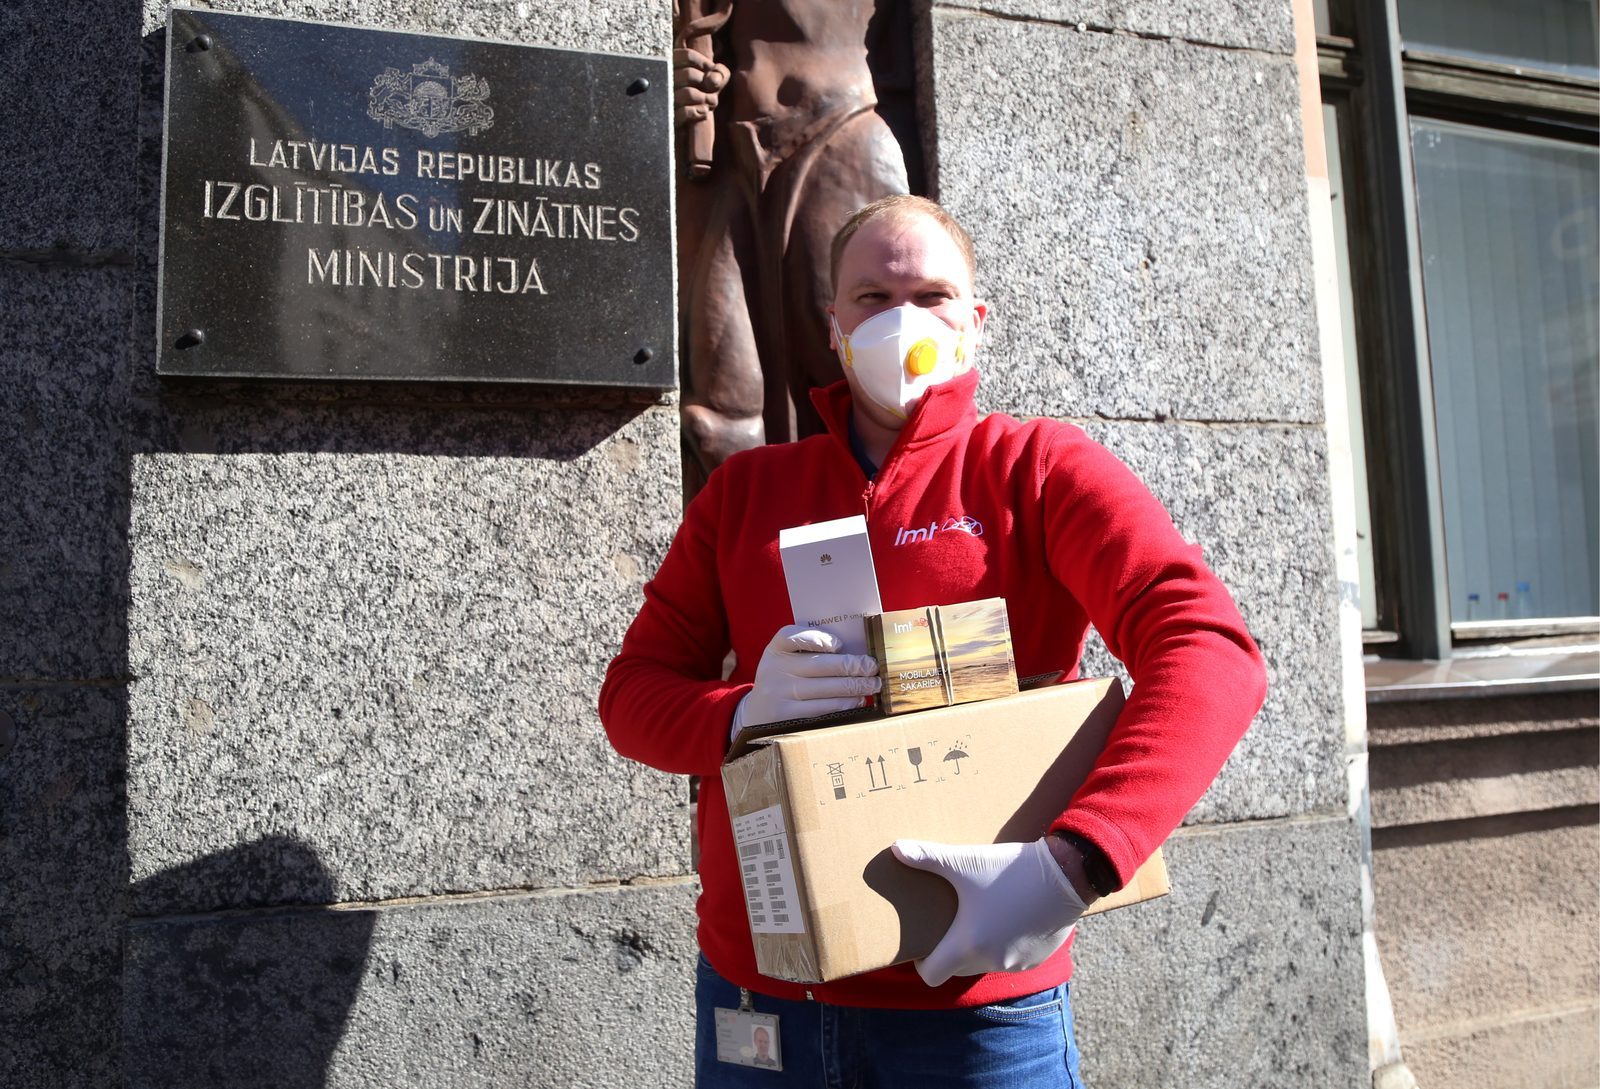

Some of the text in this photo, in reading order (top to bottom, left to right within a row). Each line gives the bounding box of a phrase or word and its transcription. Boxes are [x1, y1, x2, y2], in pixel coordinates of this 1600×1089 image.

[250, 137, 601, 190] LATVIJAS REPUBLIKAS
[204, 180, 640, 243] IZGLĪTĪBAS UN ZINĀTNES
[308, 248, 548, 295] MINISTRIJA
[894, 521, 938, 546] lmt
[808, 615, 842, 628] HUAWEI
[900, 679, 942, 692] SAKARIEM
